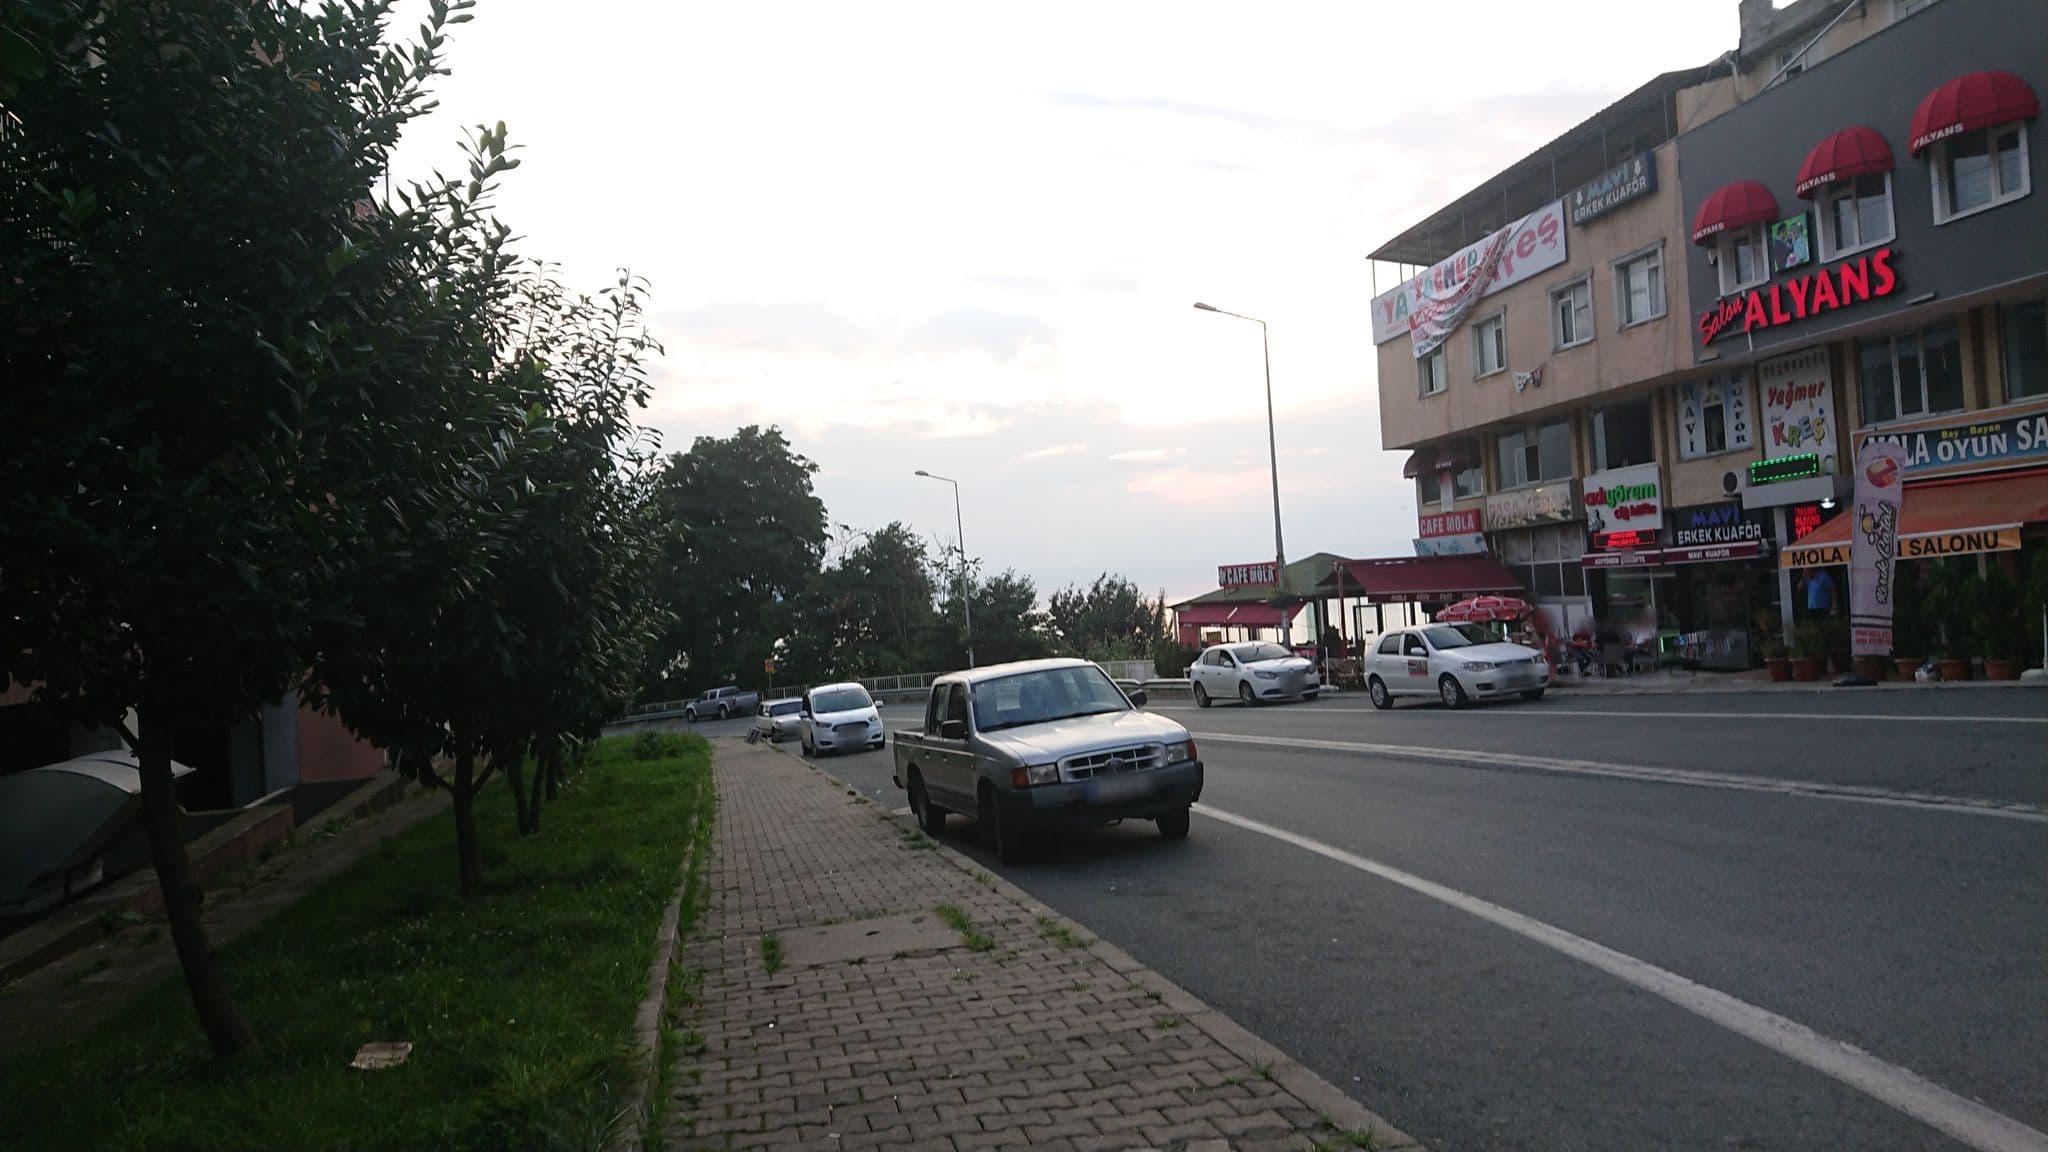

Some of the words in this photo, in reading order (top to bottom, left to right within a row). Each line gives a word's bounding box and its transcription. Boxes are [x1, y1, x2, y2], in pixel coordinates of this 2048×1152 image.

[1574, 196, 1605, 222] ERKEK
[1605, 175, 1647, 207] KUAFÖR
[1699, 297, 1744, 346] Salon
[1744, 247, 1897, 333] ALYANS
[1767, 380, 1826, 411] Yağmur
[1941, 429, 1959, 440] Bay
[1970, 423, 2002, 436] Bayan
[1937, 432, 2008, 462] OYUN
[1420, 517, 1444, 535] CAFE
[1446, 513, 1474, 532] MOLA
[1677, 529, 1713, 545] ERKEK
[1714, 520, 1762, 542] KUAFÖR
[1792, 548, 1844, 566] MOLA
[1909, 533, 1999, 557] SALONU
[1227, 567, 1249, 585] CAFE
[1250, 564, 1275, 585] MOLA
